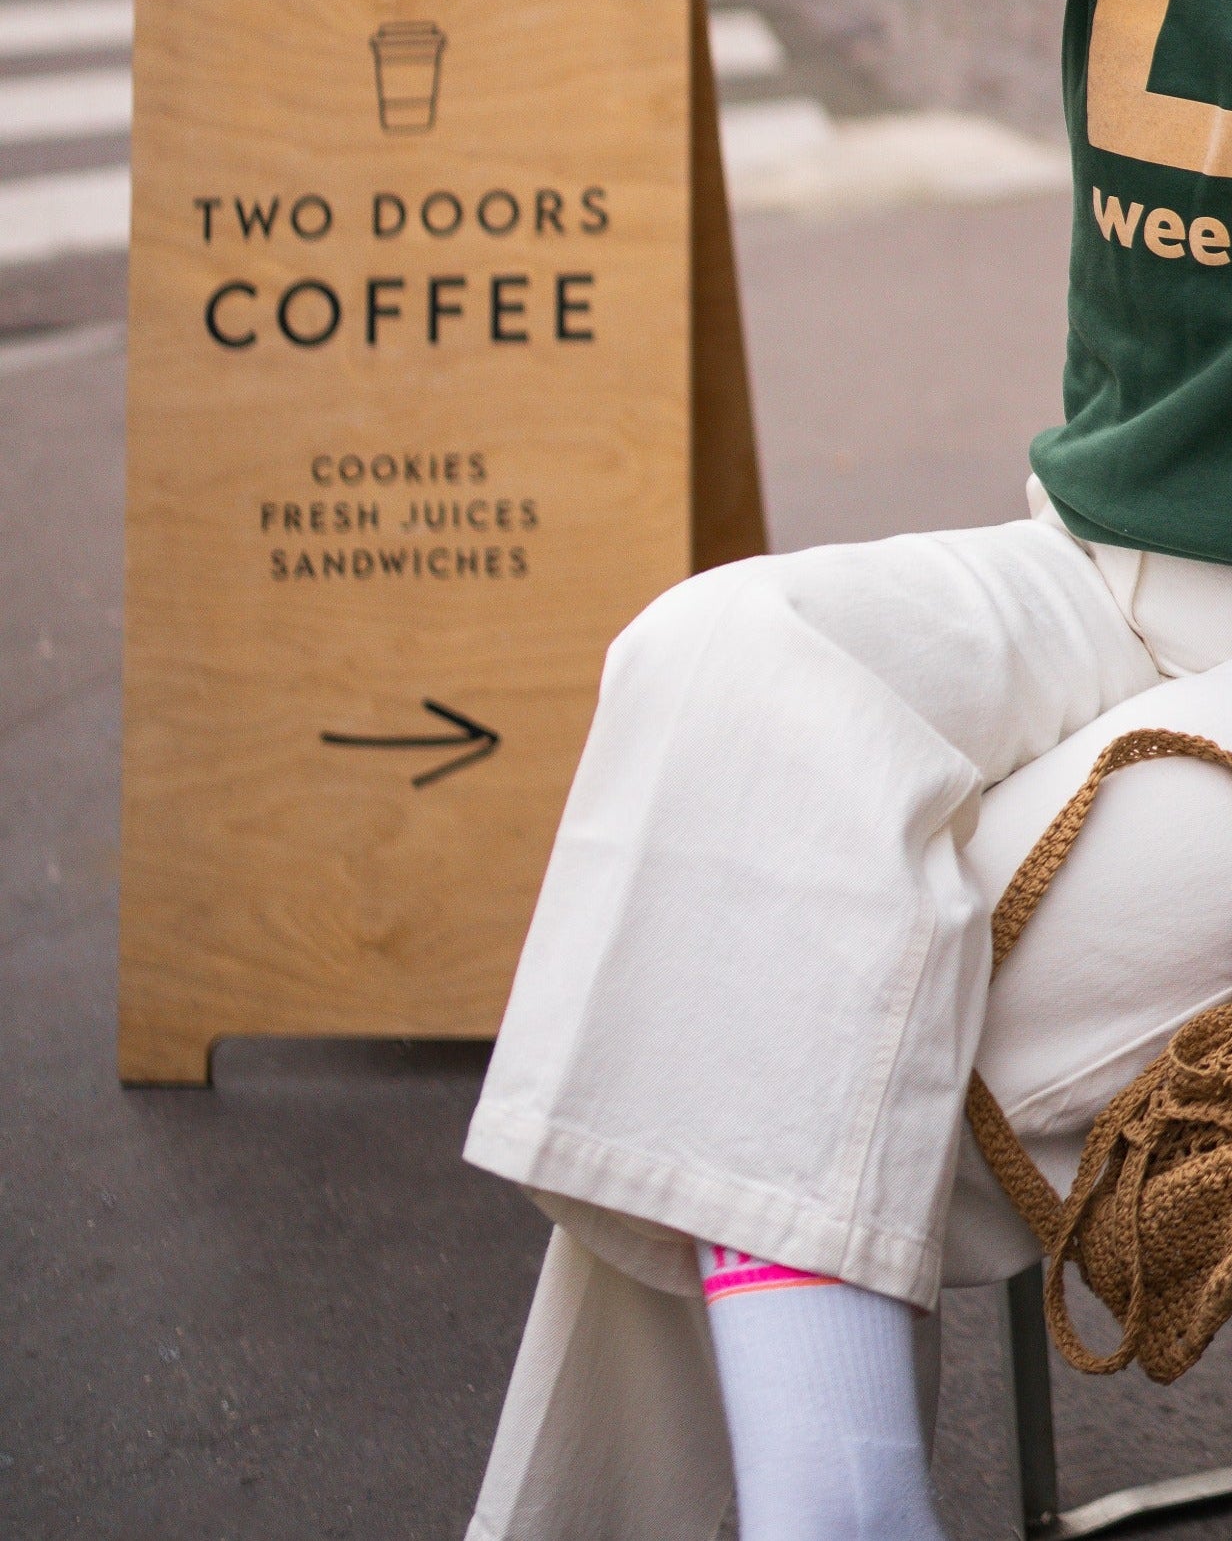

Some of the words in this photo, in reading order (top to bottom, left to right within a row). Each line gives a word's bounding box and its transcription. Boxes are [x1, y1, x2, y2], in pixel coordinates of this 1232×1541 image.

[194, 195, 334, 242] TWO
[372, 187, 611, 238] DOORS
[205, 273, 597, 348] COFFEE
[310, 452, 487, 485] COOKIES
[261, 500, 380, 532] FRESH
[401, 498, 539, 532] JUICES
[271, 546, 529, 581] SANDWICHES
